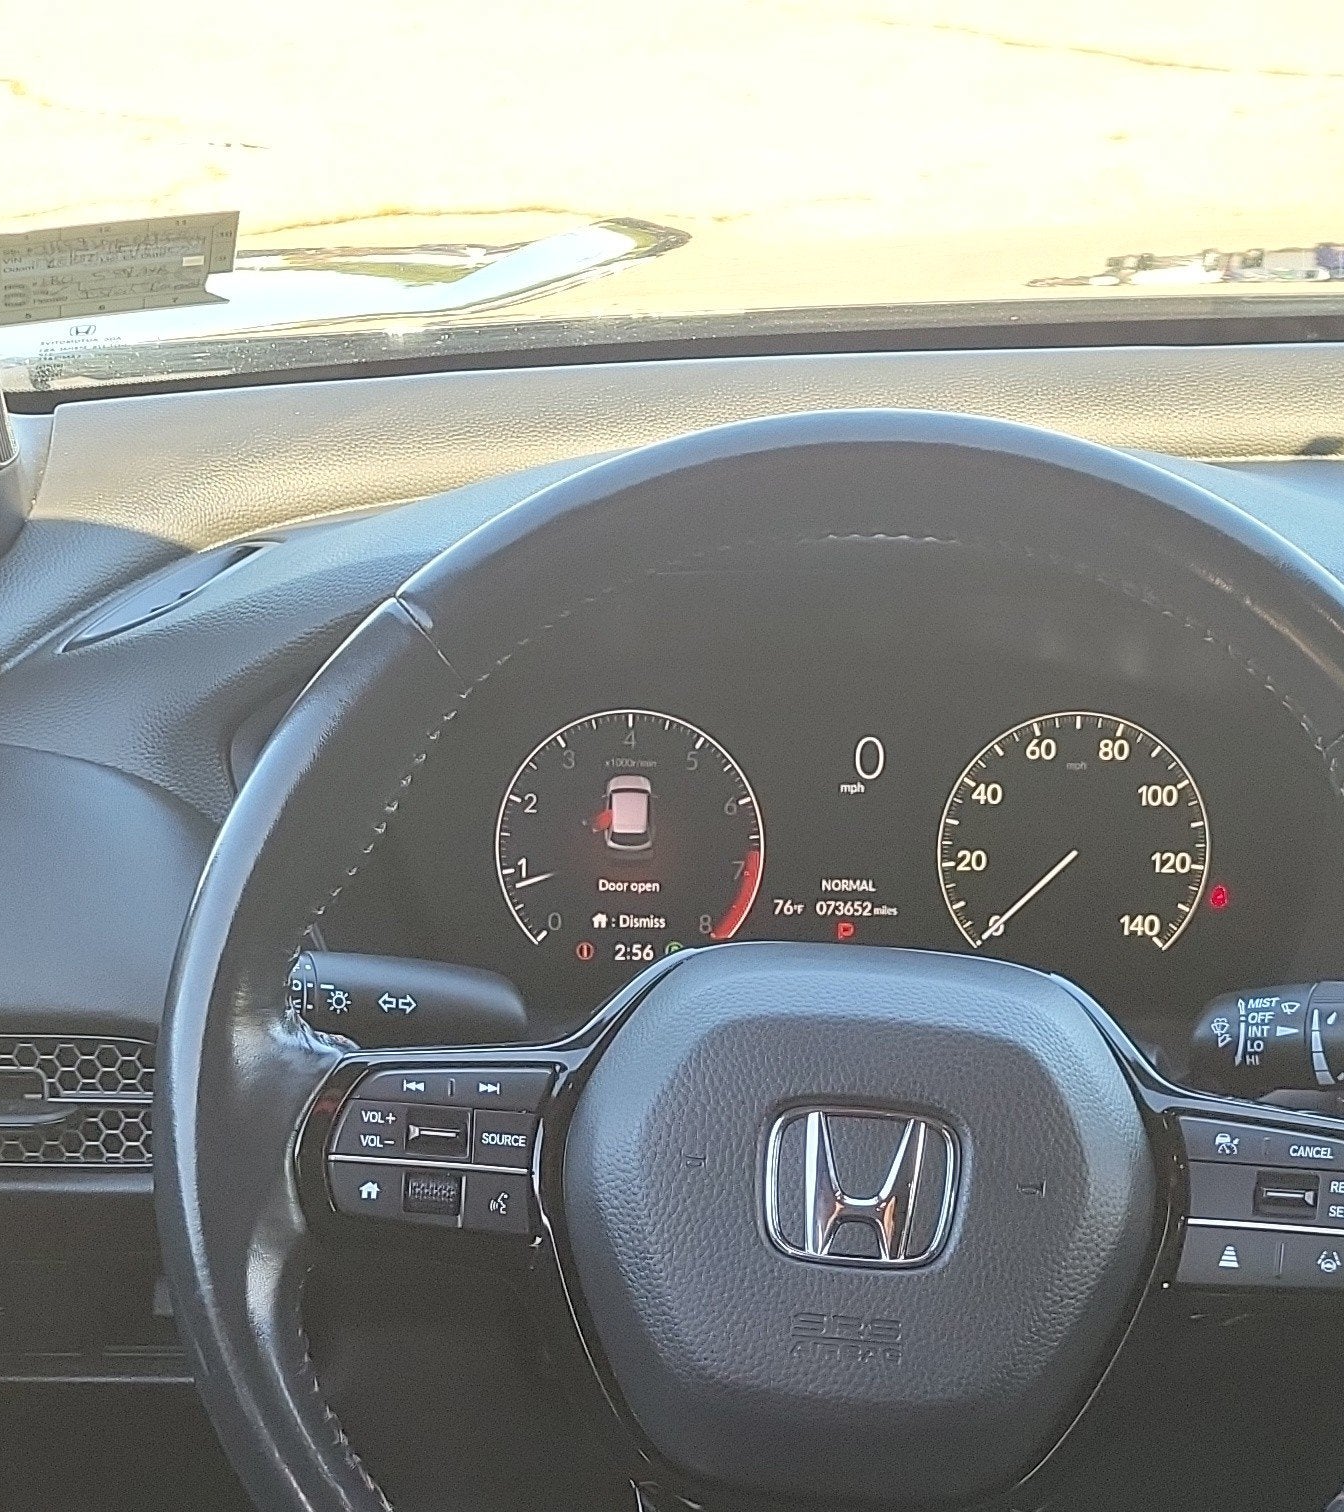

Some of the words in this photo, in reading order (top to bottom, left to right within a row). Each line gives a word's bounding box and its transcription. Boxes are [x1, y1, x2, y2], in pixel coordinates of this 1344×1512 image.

[624, 732, 637, 749] 4
[1026, 738, 1057, 761] 60
[1098, 738, 1130, 761] 80
[563, 750, 576, 768] 3
[686, 752, 699, 769] 5
[855, 736, 885, 780] 0
[840, 783, 865, 795] mph
[971, 782, 1003, 806] 40
[1138, 784, 1179, 807] 100
[523, 794, 538, 813] 2
[724, 797, 737, 815] 6
[517, 858, 527, 878] 1
[956, 850, 987, 872] 20
[1151, 852, 1192, 874] 120
[732, 861, 745, 880] 7
[598, 879, 628, 892] Door
[630, 882, 660, 894] open
[821, 878, 876, 892] NORMAL
[816, 900, 872, 916] 073652
[873, 905, 898, 916] miles
[548, 912, 562, 931] 0
[619, 914, 666, 928] Dismiss
[699, 914, 712, 934] 8
[989, 914, 1005, 937] 0
[1120, 914, 1161, 937] 140
[837, 922, 855, 939] P
[614, 943, 654, 961] 2:56
[1248, 997, 1280, 1009] MIST
[1248, 1012, 1275, 1024] OFF
[1248, 1026, 1271, 1038] INT
[1247, 1040, 1264, 1052] LO
[1246, 1054, 1260, 1066] HI
[481, 1132, 527, 1148] SOURCE
[1289, 1145, 1334, 1160] CANCEL
[792, 1312, 902, 1340] SRS
